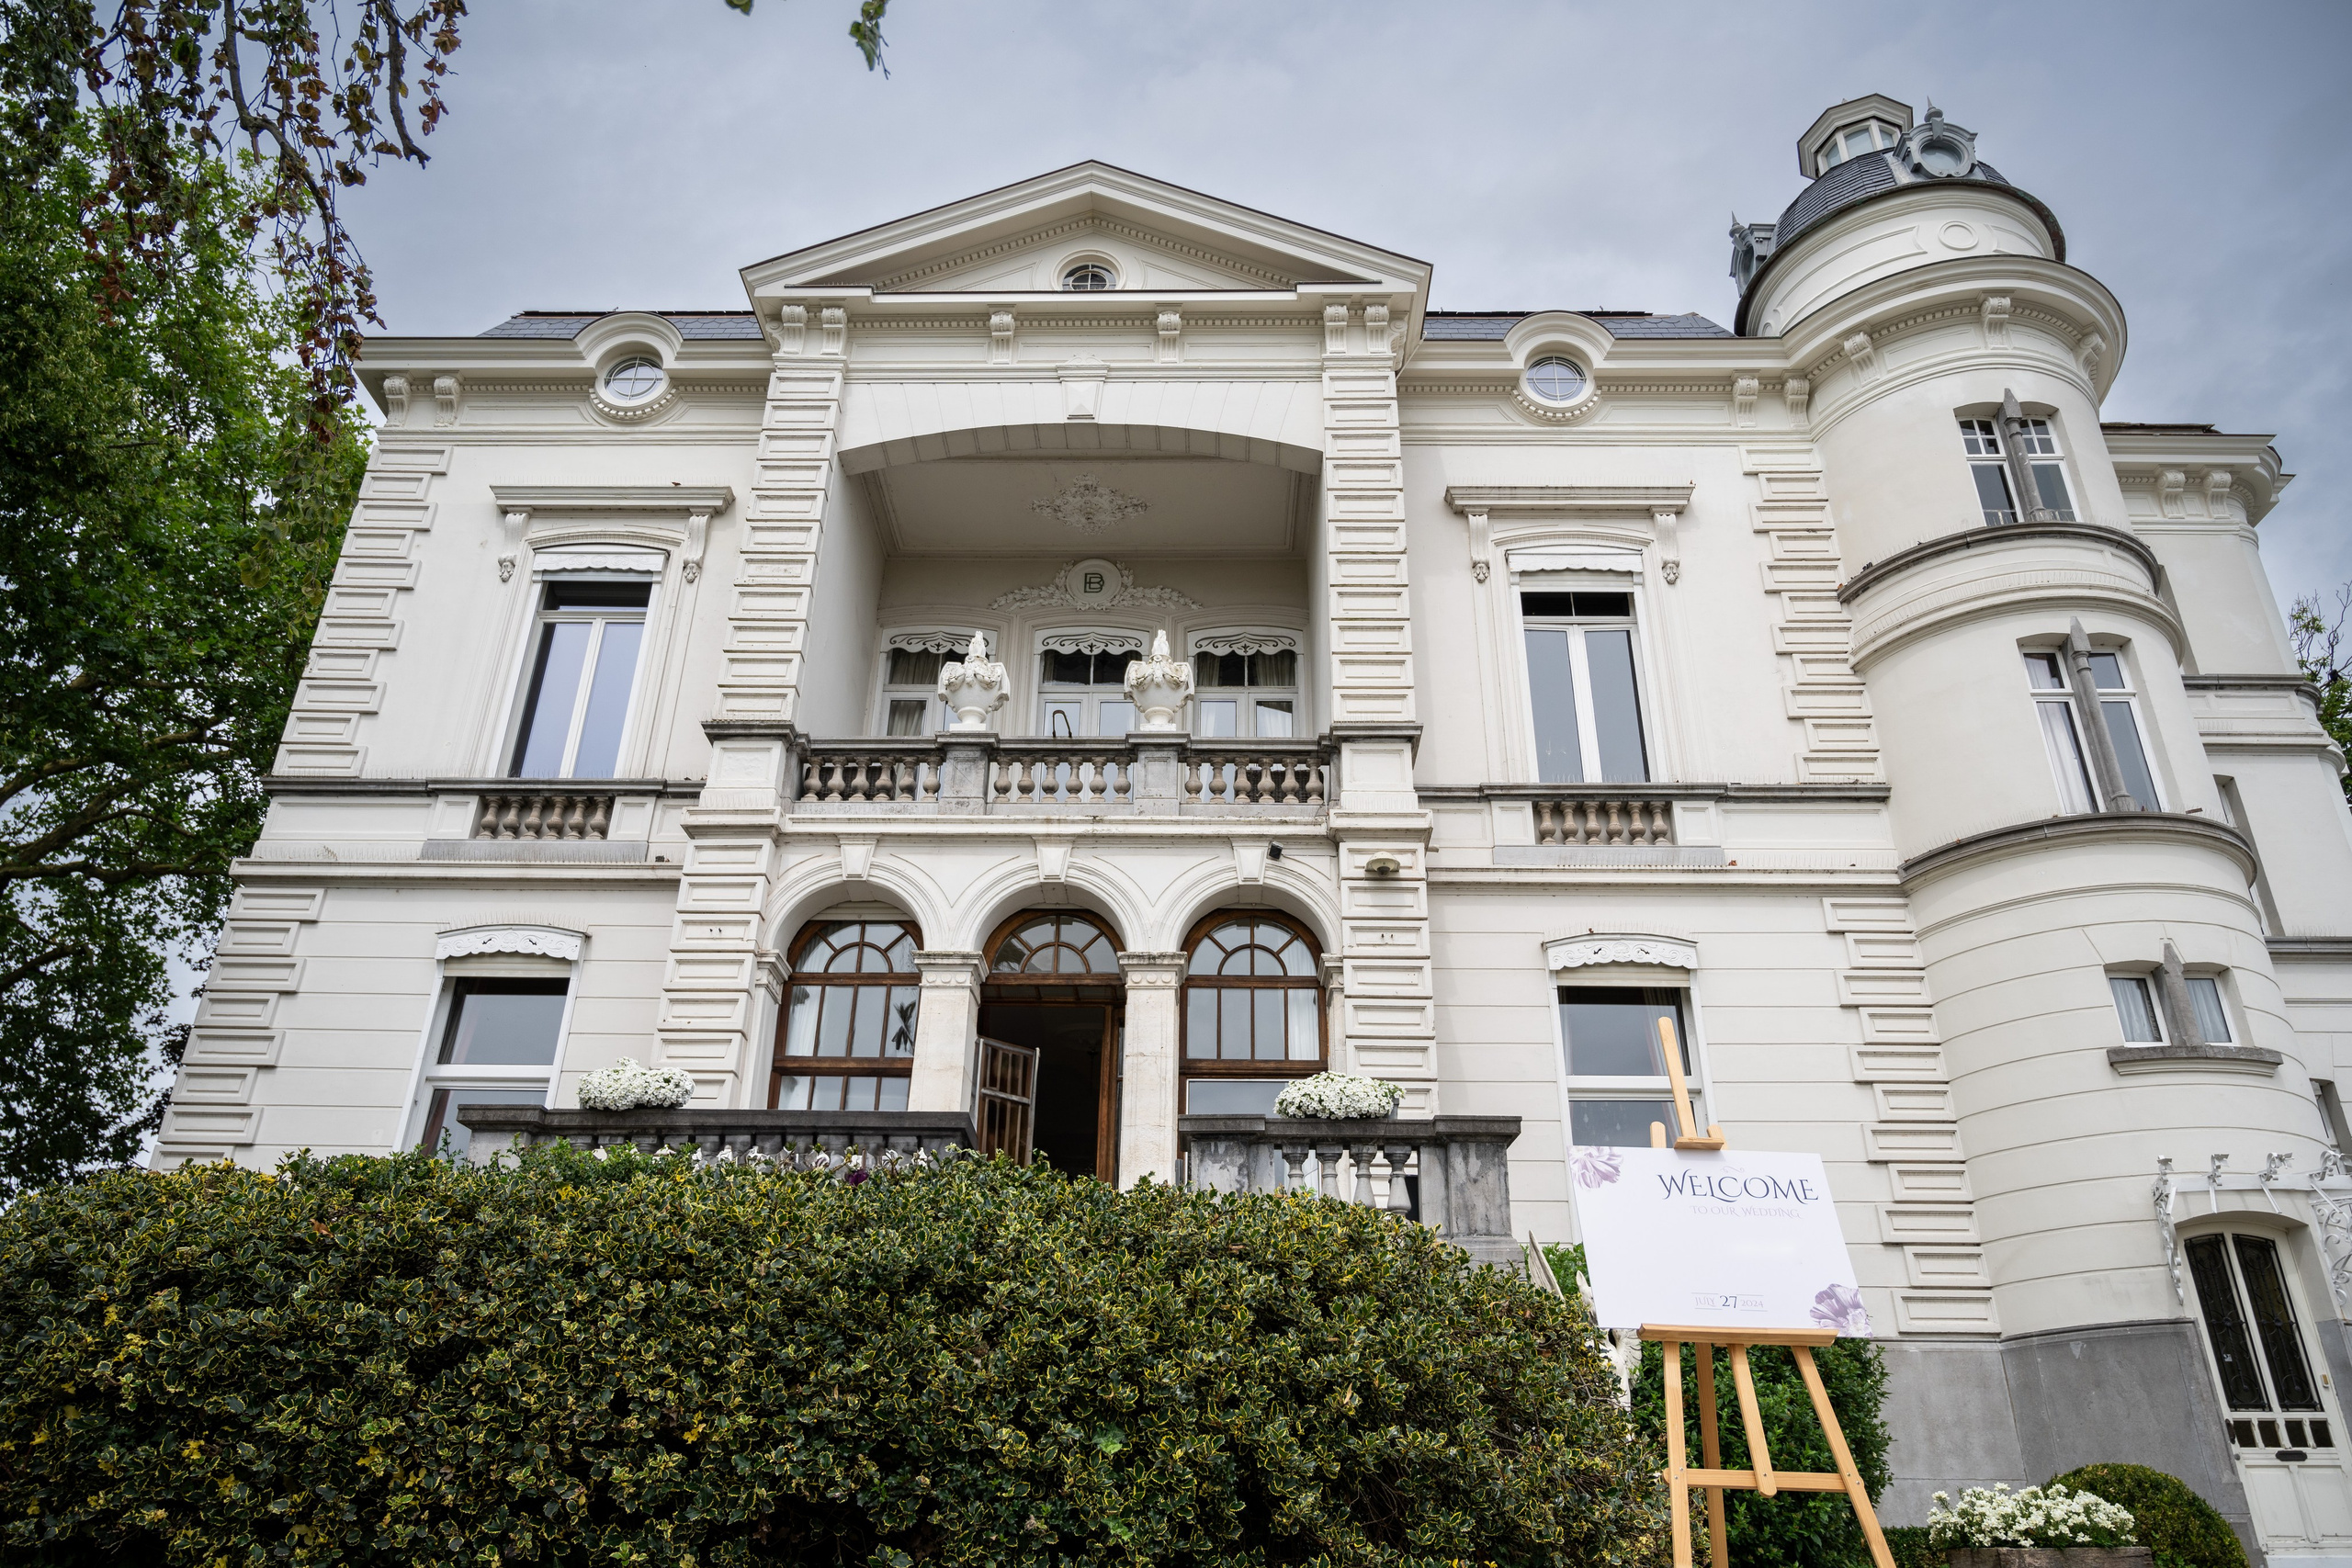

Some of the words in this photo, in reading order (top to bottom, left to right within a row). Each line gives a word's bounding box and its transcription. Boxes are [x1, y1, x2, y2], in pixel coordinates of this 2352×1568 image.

[1657, 1168, 1819, 1205] WELCOME
[1690, 1205, 1708, 1215] TO
[1711, 1205, 1739, 1217] OUR
[1741, 1206, 1803, 1219] WEDDING
[1695, 1296, 1716, 1307] JULY
[1720, 1295, 1737, 1309] 27
[1741, 1299, 1764, 1309] 2024
